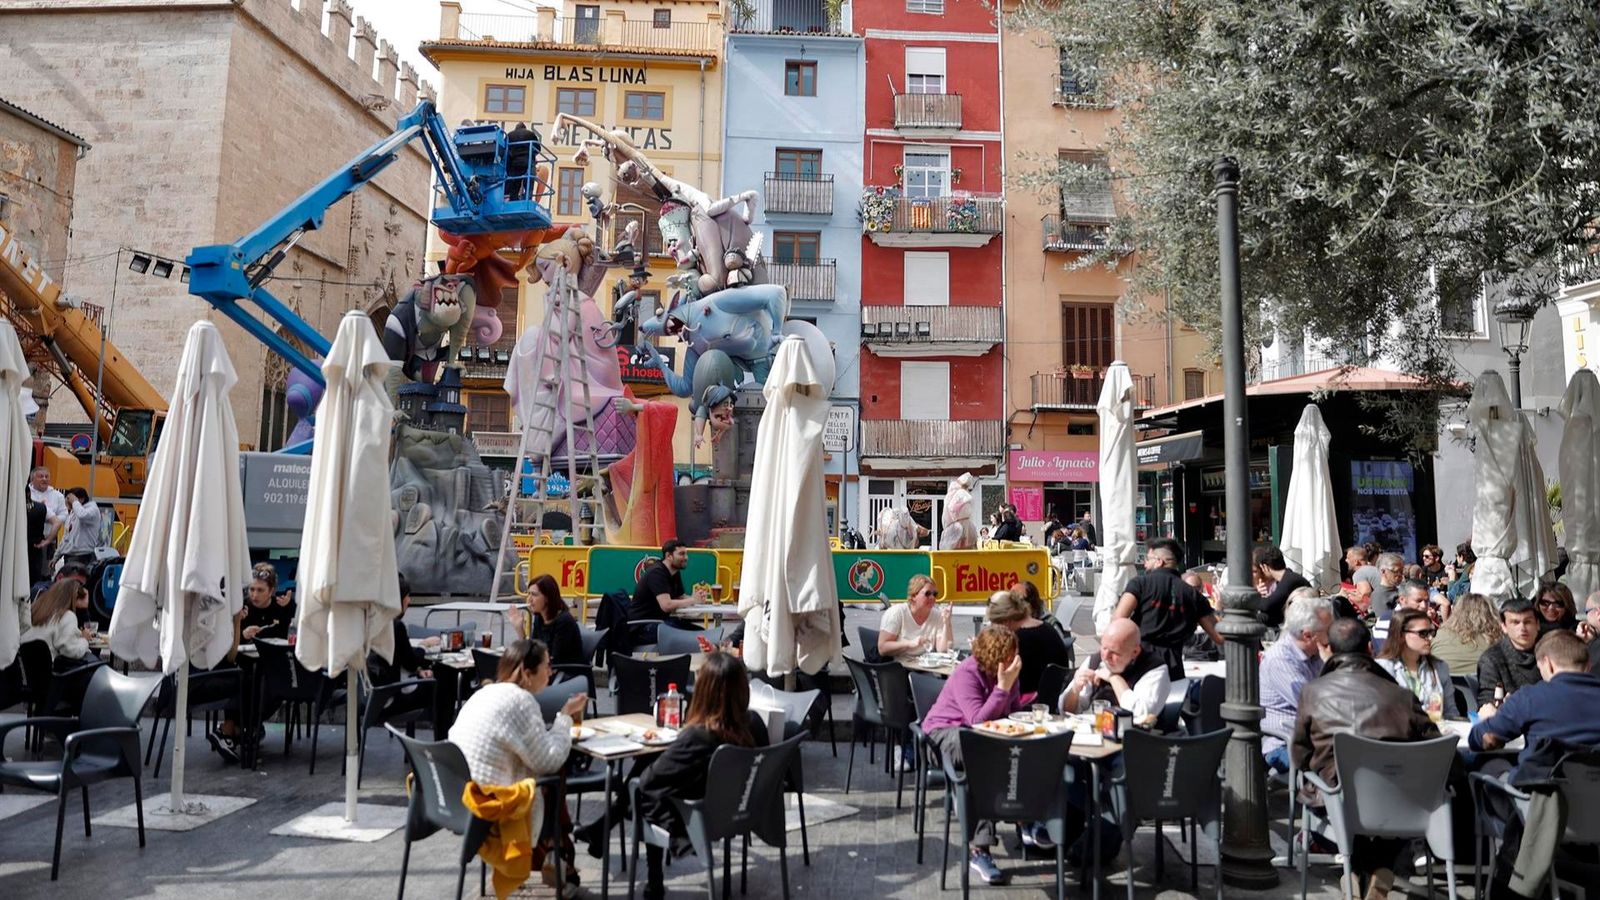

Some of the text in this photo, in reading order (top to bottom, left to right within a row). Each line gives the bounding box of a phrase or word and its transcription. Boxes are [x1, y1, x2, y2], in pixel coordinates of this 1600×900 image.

[505, 65, 646, 84] HIJA BLAS LUNA
[1017, 456, 1046, 470] Julio
[1052, 456, 1095, 471] Ignacio
[268, 478, 307, 489] ALQUILE
[1357, 487, 1374, 495] NOS
[956, 564, 1019, 592] Fallera
[1007, 757, 1019, 802] Heineken
[1163, 755, 1177, 799] Heineken
